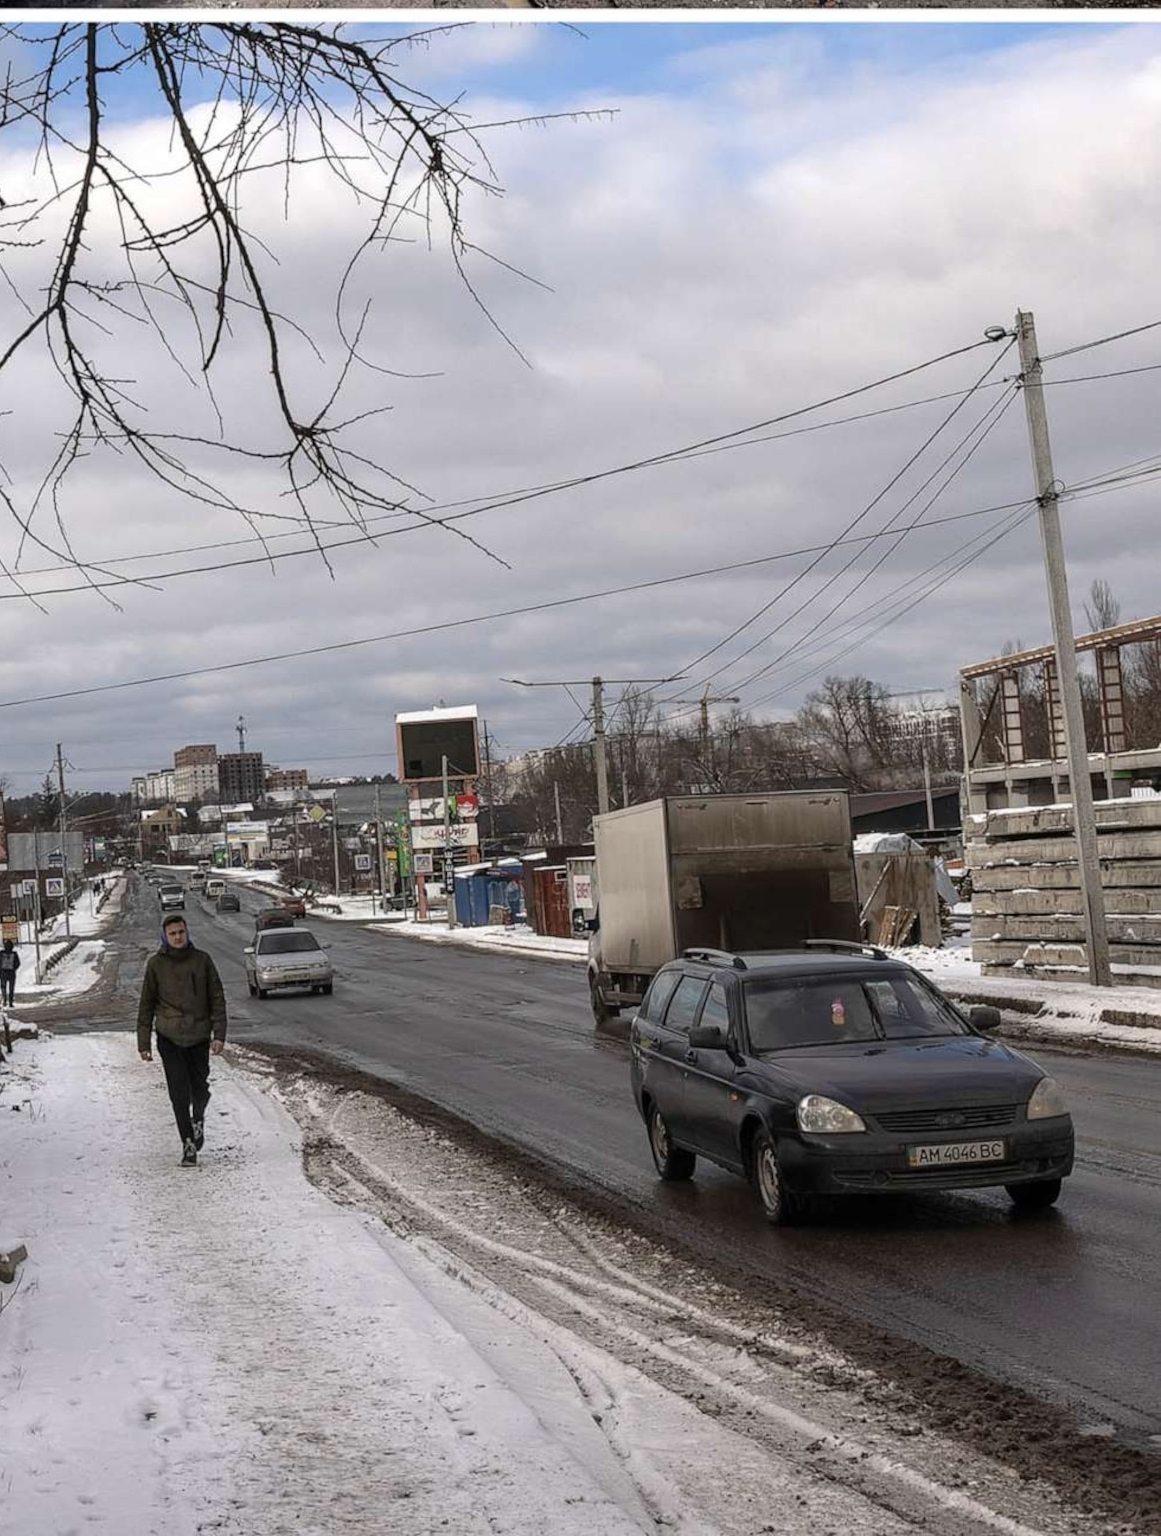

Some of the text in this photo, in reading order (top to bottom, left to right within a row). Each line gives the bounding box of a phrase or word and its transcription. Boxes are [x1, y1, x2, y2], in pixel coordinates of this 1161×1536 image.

[919, 1142, 1002, 1163] AM 4046 BC
